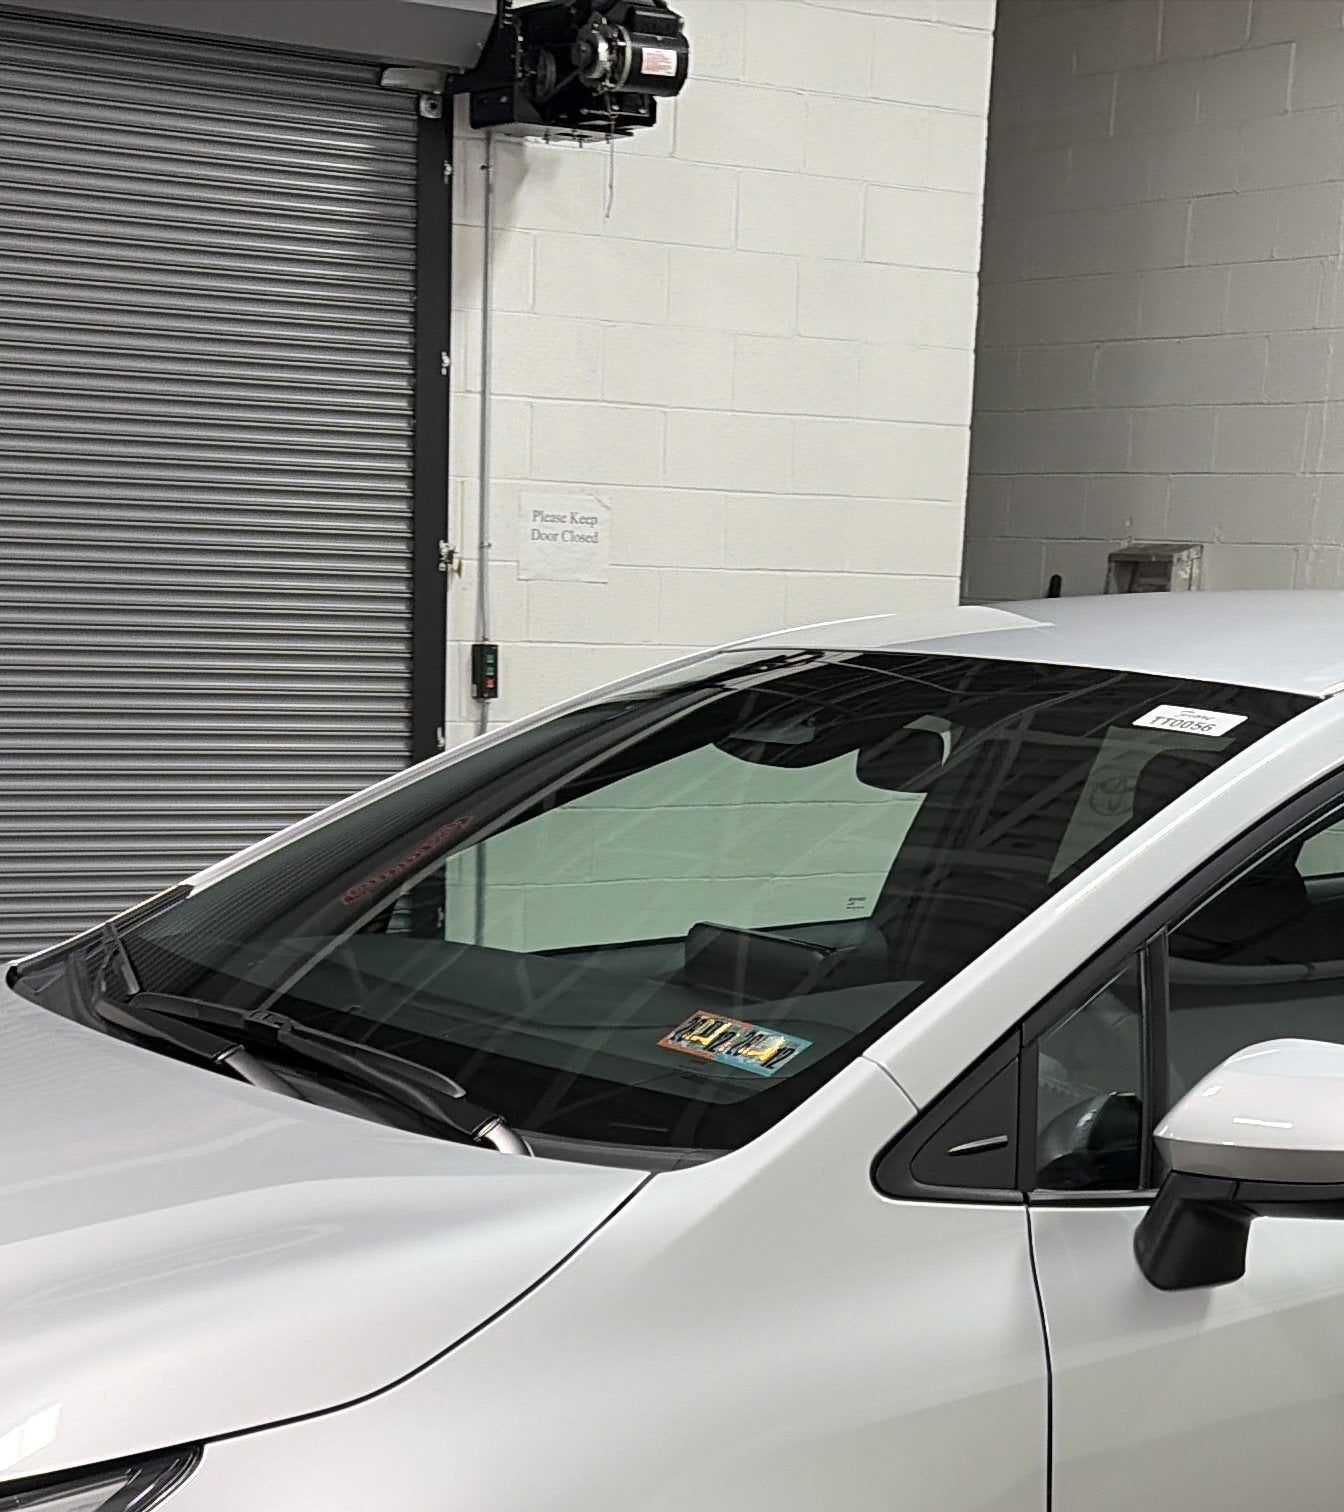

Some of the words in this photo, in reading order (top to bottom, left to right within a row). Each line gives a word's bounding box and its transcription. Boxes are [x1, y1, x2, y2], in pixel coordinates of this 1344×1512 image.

[531, 509, 567, 524] Please
[569, 511, 598, 528] Keep
[530, 528, 559, 542] Door
[561, 530, 599, 544] Closed
